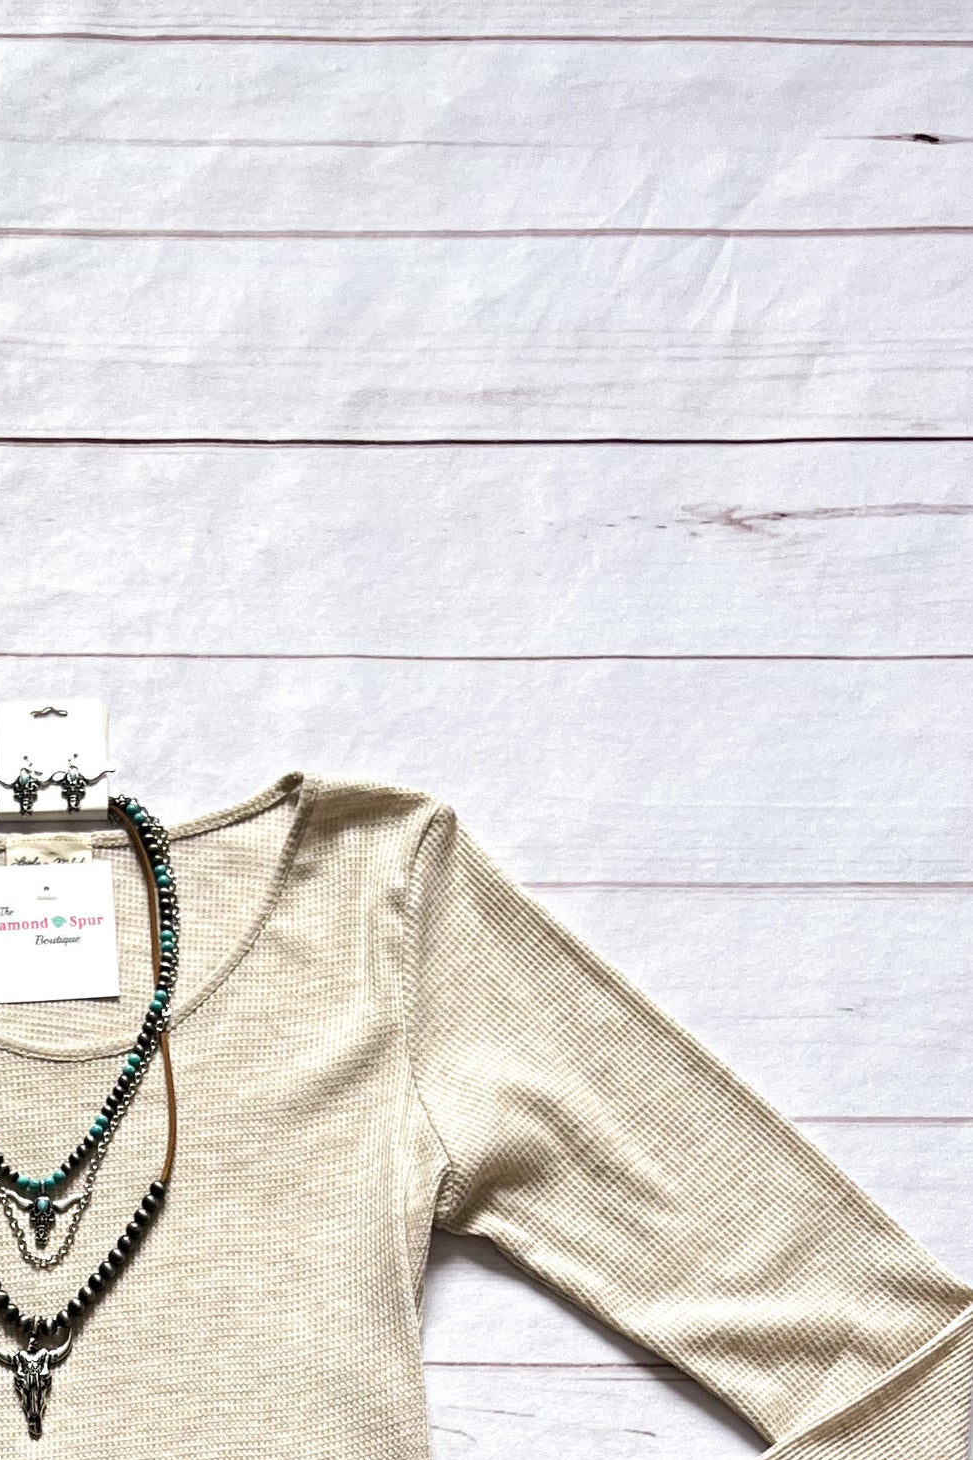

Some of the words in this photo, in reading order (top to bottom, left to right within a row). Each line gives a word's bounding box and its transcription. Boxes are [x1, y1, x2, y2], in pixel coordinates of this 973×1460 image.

[0, 906, 14, 917] The
[69, 915, 104, 929] Spur
[35, 934, 81, 946] Boutique
